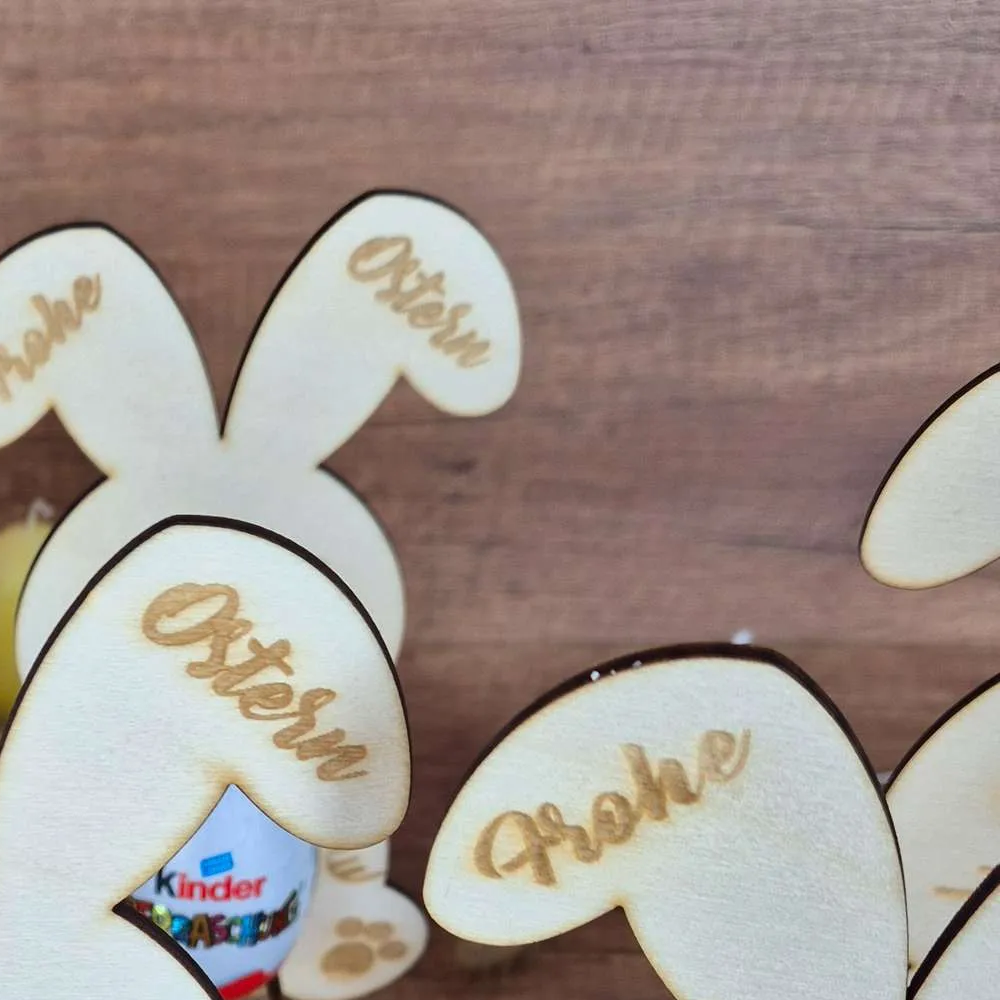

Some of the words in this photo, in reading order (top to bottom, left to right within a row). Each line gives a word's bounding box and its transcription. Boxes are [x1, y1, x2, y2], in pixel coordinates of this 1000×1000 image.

[346, 235, 493, 369] Ostern
[141, 582, 372, 782] Ostern
[473, 728, 751, 887] Frohe
[154, 868, 267, 902] Kinder
